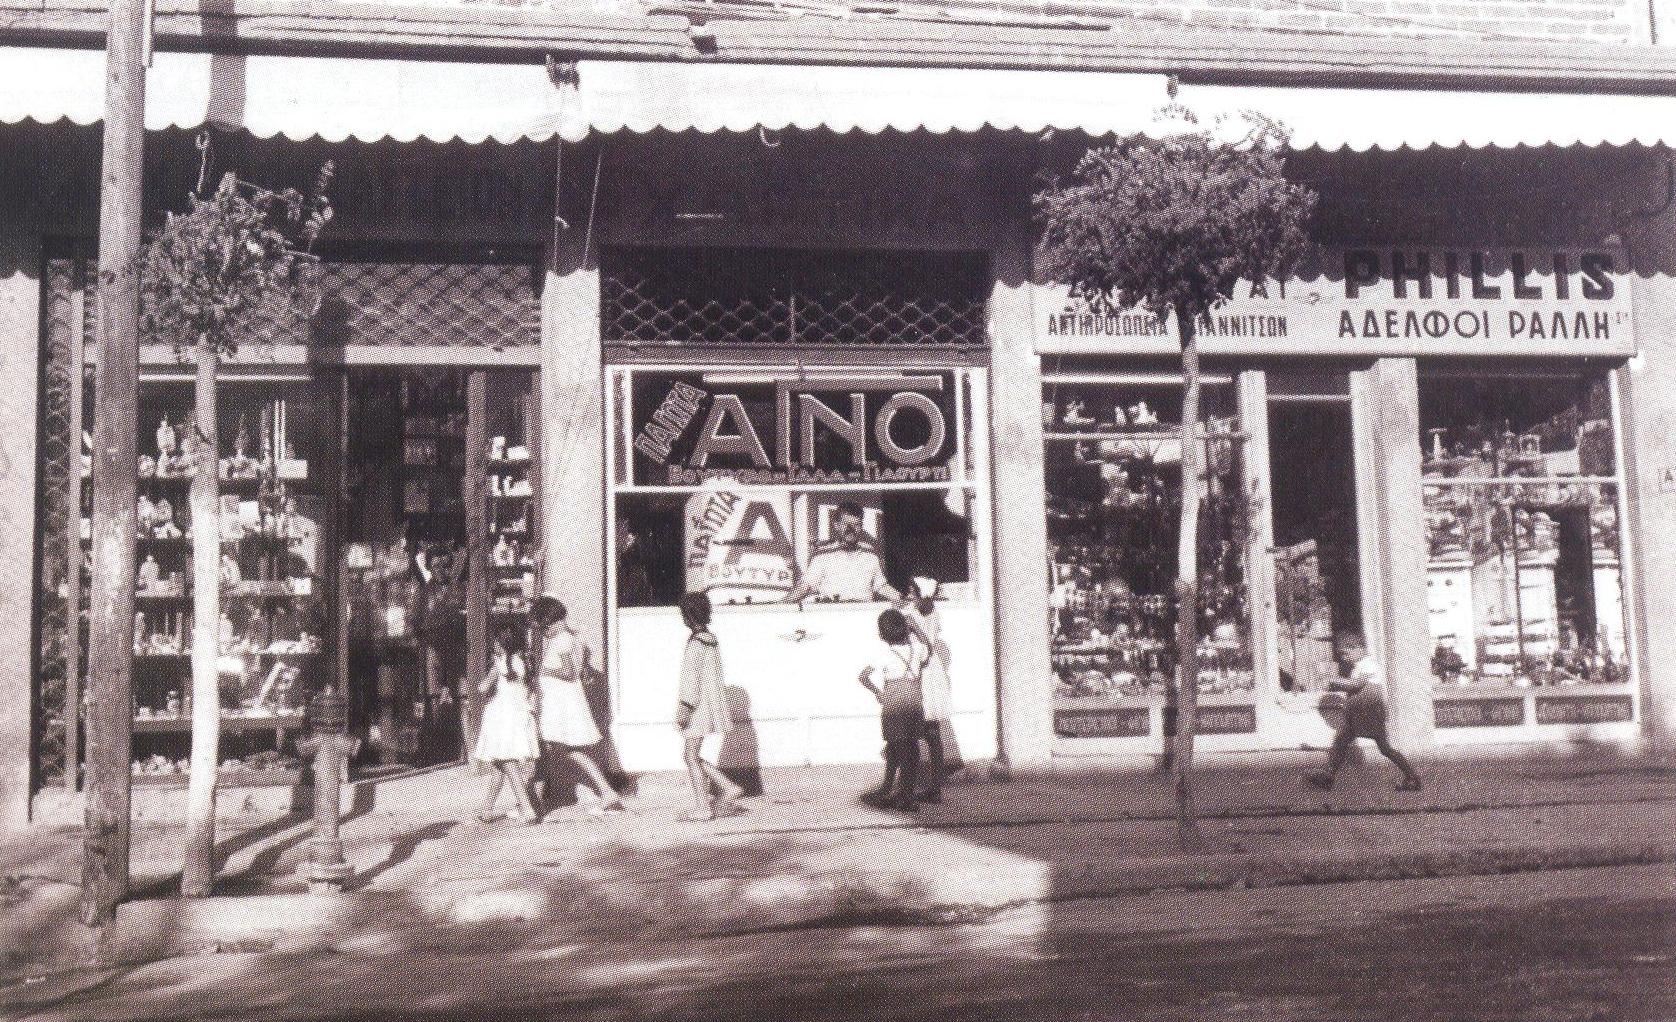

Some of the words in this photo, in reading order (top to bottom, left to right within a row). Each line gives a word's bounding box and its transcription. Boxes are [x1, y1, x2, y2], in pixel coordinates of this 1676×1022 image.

[1344, 250, 1614, 300] PHILLIS
[1338, 309, 1490, 338] ΑΔΕΛΦΟΙ
[1509, 310, 1610, 339] ΡΑΛΛΗ
